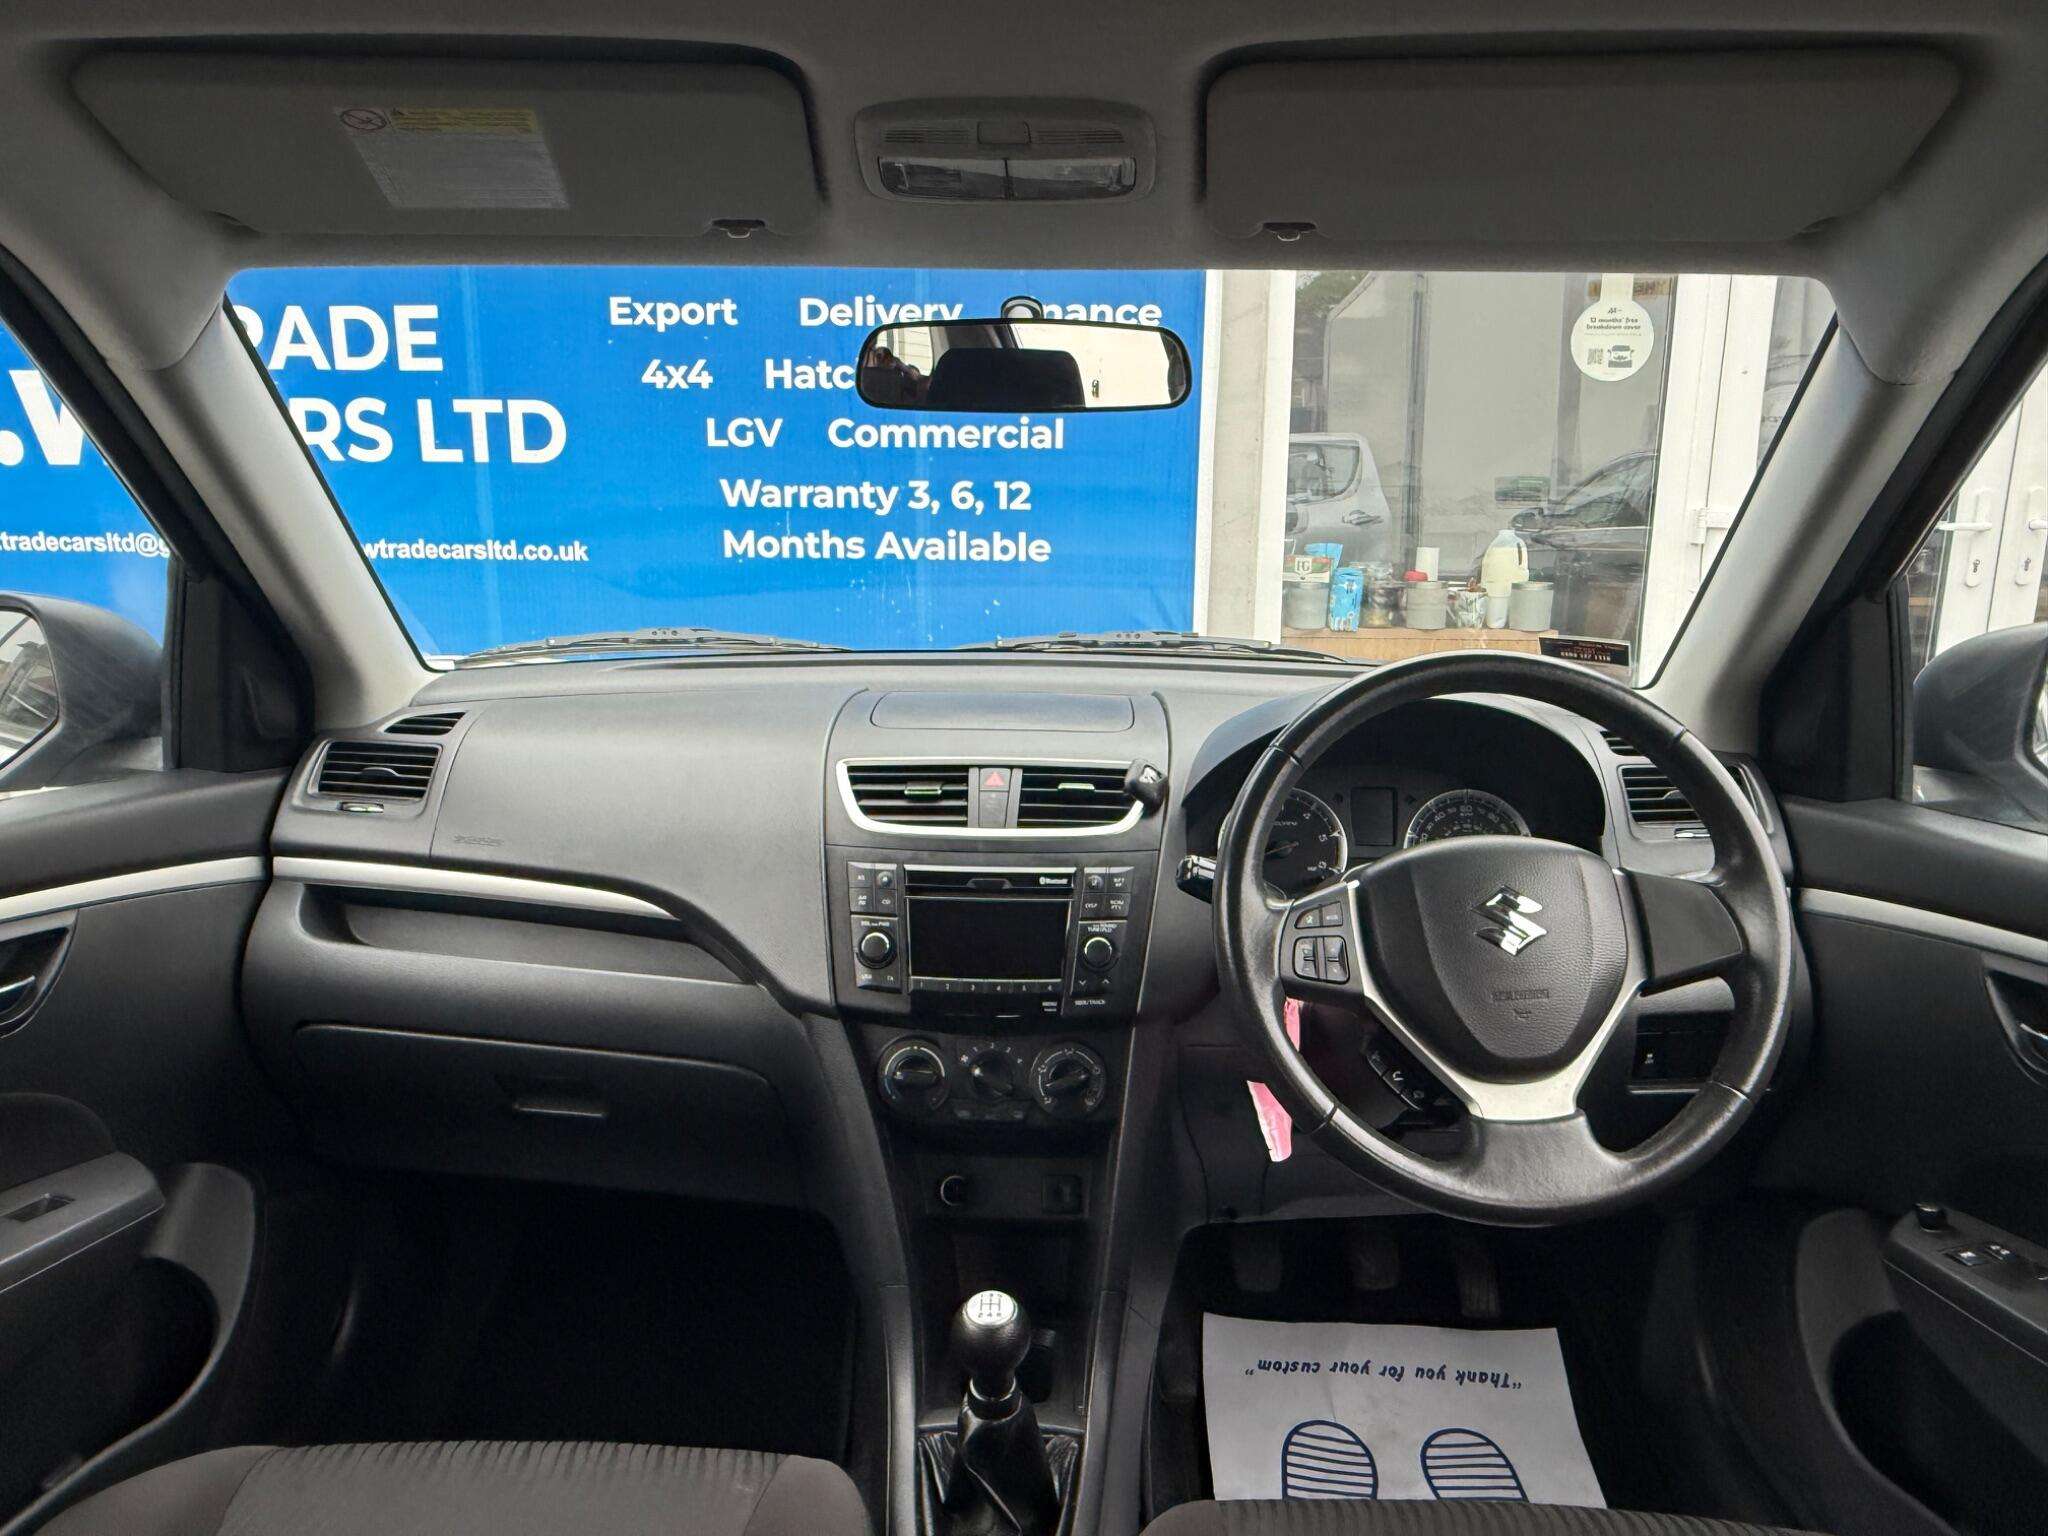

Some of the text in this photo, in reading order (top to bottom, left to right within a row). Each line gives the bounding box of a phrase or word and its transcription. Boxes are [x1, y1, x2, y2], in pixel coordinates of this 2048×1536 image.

[609, 296, 738, 328] Export
[799, 295, 963, 327] Delivery
[1042, 302, 1163, 328] nance
[642, 358, 714, 389] 4x4
[765, 358, 856, 390] Hatc
[289, 397, 567, 464] RS LTD
[707, 418, 783, 448] LGV
[828, 417, 1064, 449] Commercial
[720, 479, 1032, 517] Warranty 3, 6, 12
[723, 530, 1052, 562] Months Available
[1329, 1359, 1372, 1375] your
[1379, 1365, 1405, 1382] for
[1415, 1364, 1447, 1381] you
